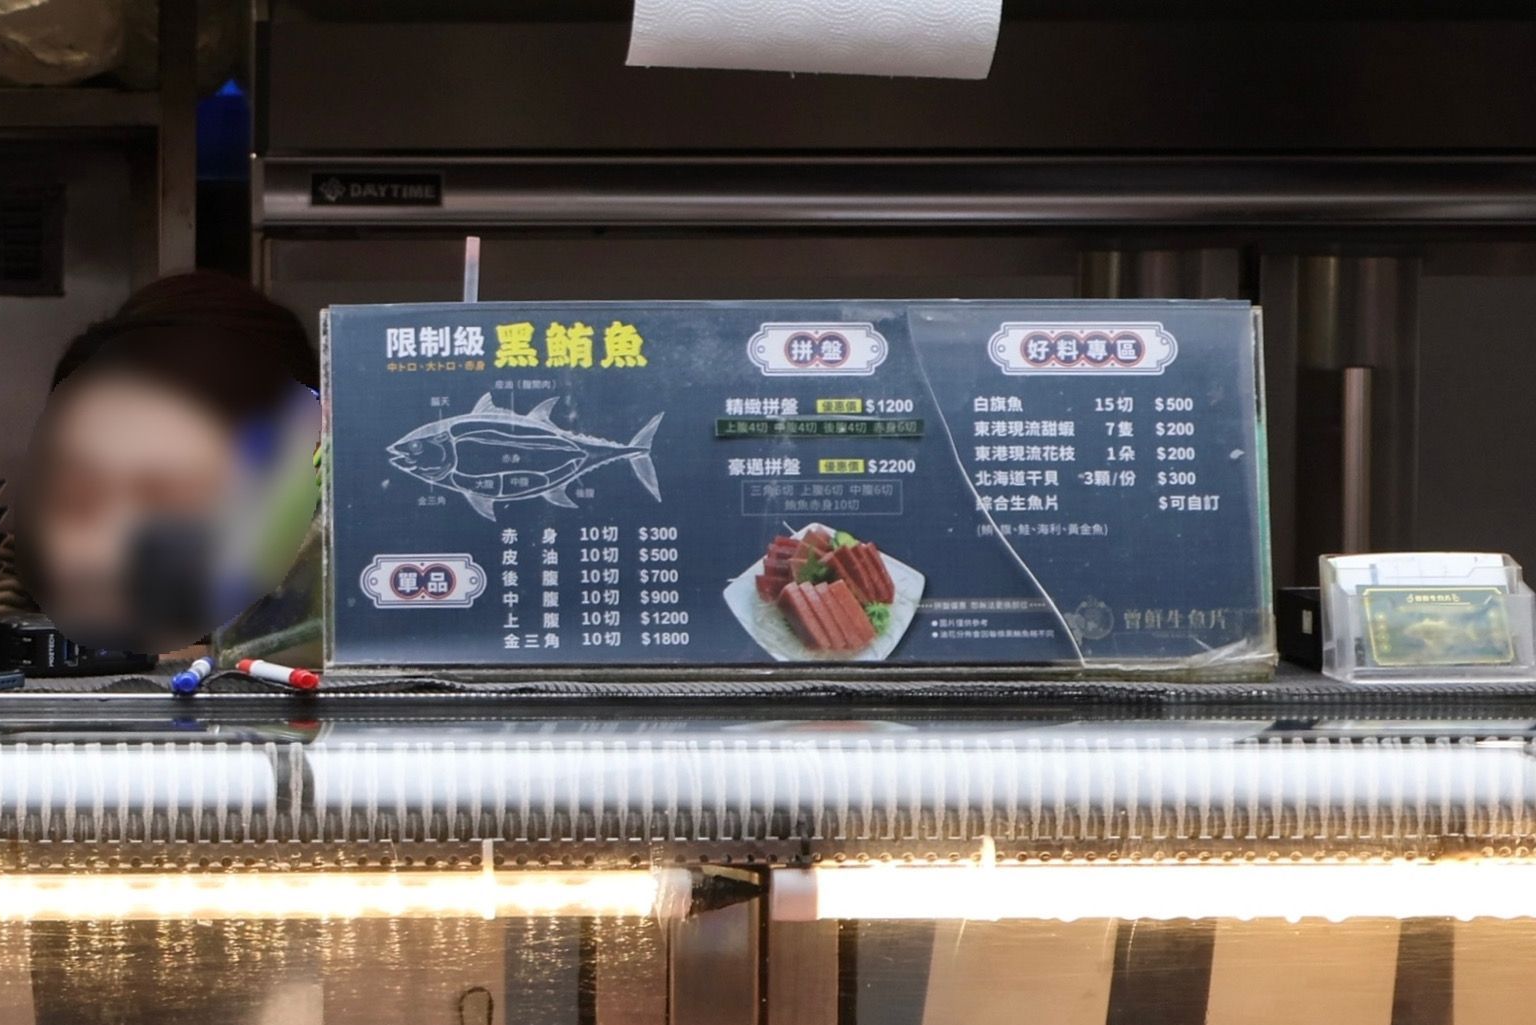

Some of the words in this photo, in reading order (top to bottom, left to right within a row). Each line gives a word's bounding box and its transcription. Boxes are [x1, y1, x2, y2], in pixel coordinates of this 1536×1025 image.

[350, 184, 436, 199] DAYTIME
[385, 325, 485, 358] 限制級
[494, 320, 648, 369] 黑鮪魚
[791, 339, 843, 361] 拼盤
[1027, 338, 1137, 361] 好料專區
[725, 397, 799, 416] 精緻拼盤
[865, 399, 914, 414] $1200
[973, 396, 1024, 413] 白旗魚
[1095, 397, 1134, 413] 15切
[1155, 397, 1194, 412] $500
[973, 420, 1076, 437] 東港現流甜蝦
[1105, 421, 1134, 437] 7隻
[1155, 422, 1195, 437] $200
[974, 445, 1076, 462] 東港現流花枝
[1106, 446, 1136, 461] 1朵
[1156, 446, 1195, 461] $200
[728, 458, 801, 476] 豪邁拼盤
[868, 458, 916, 474] $2200
[975, 470, 1059, 487] 北海道干貝
[1158, 470, 1196, 486] $300
[975, 495, 1059, 512] 綜合生魚片
[579, 527, 618, 542] 10切
[638, 527, 678, 542] $300
[579, 548, 619, 563] 10切
[639, 548, 678, 563] $500
[398, 571, 449, 594] 單品
[580, 569, 619, 584] 10切
[639, 569, 679, 584] $700
[581, 590, 619, 605] 10切
[640, 590, 679, 605] $900
[581, 611, 620, 626] 10切
[641, 611, 689, 626] $1200
[503, 633, 560, 650] 金三角
[582, 632, 621, 647] 10切
[641, 632, 690, 647] $1800
